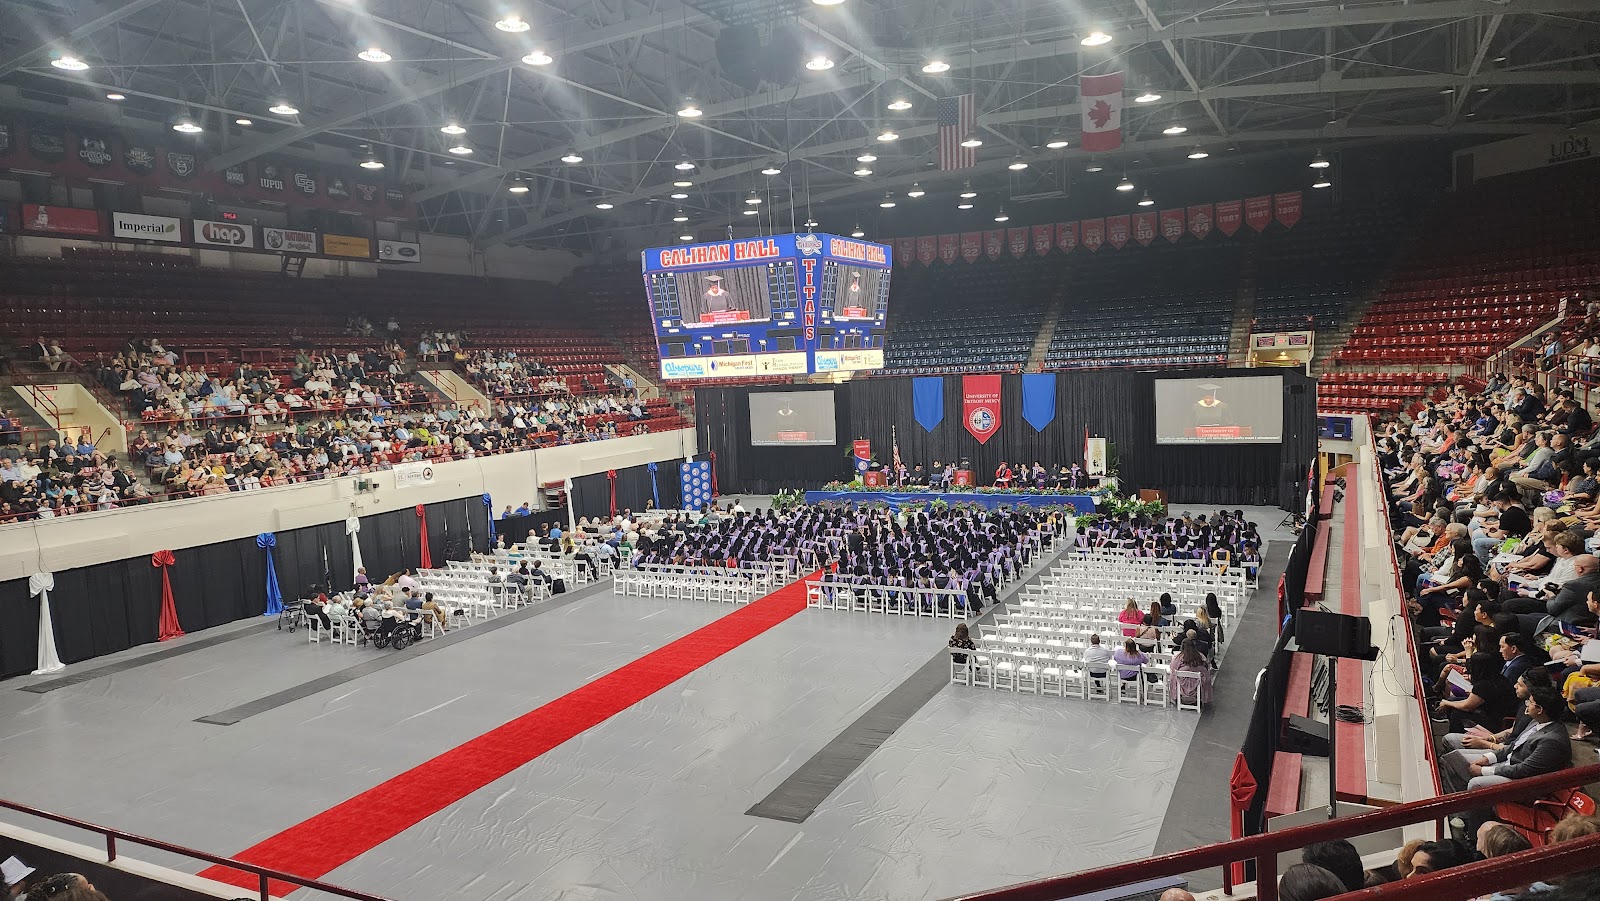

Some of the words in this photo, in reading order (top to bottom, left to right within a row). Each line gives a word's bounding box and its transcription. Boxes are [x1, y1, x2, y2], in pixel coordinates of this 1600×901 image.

[260, 178, 284, 191] IUPUI
[1219, 214, 1240, 223] 1987
[119, 220, 165, 234] Imperial
[1165, 227, 1182, 237] 25
[209, 225, 242, 244] hap
[284, 231, 314, 244] NATIONAL
[1110, 232, 1127, 242] 45
[1137, 230, 1153, 240] 50
[1035, 240, 1050, 250] 34
[1061, 238, 1076, 248] 42
[1085, 235, 1102, 245] 44
[660, 243, 731, 268] CALIHAN
[734, 238, 779, 261] HALL
[830, 237, 866, 261] CALIHAN
[865, 244, 887, 265] HALL
[963, 248, 978, 257] 22
[987, 246, 1001, 255] 24
[1011, 244, 1026, 253] 32
[943, 250, 955, 259] 17
[801, 258, 817, 341] TITANS
[719, 359, 741, 368] Michigan
[741, 359, 754, 367] First
[1573, 796, 1585, 809] 22
